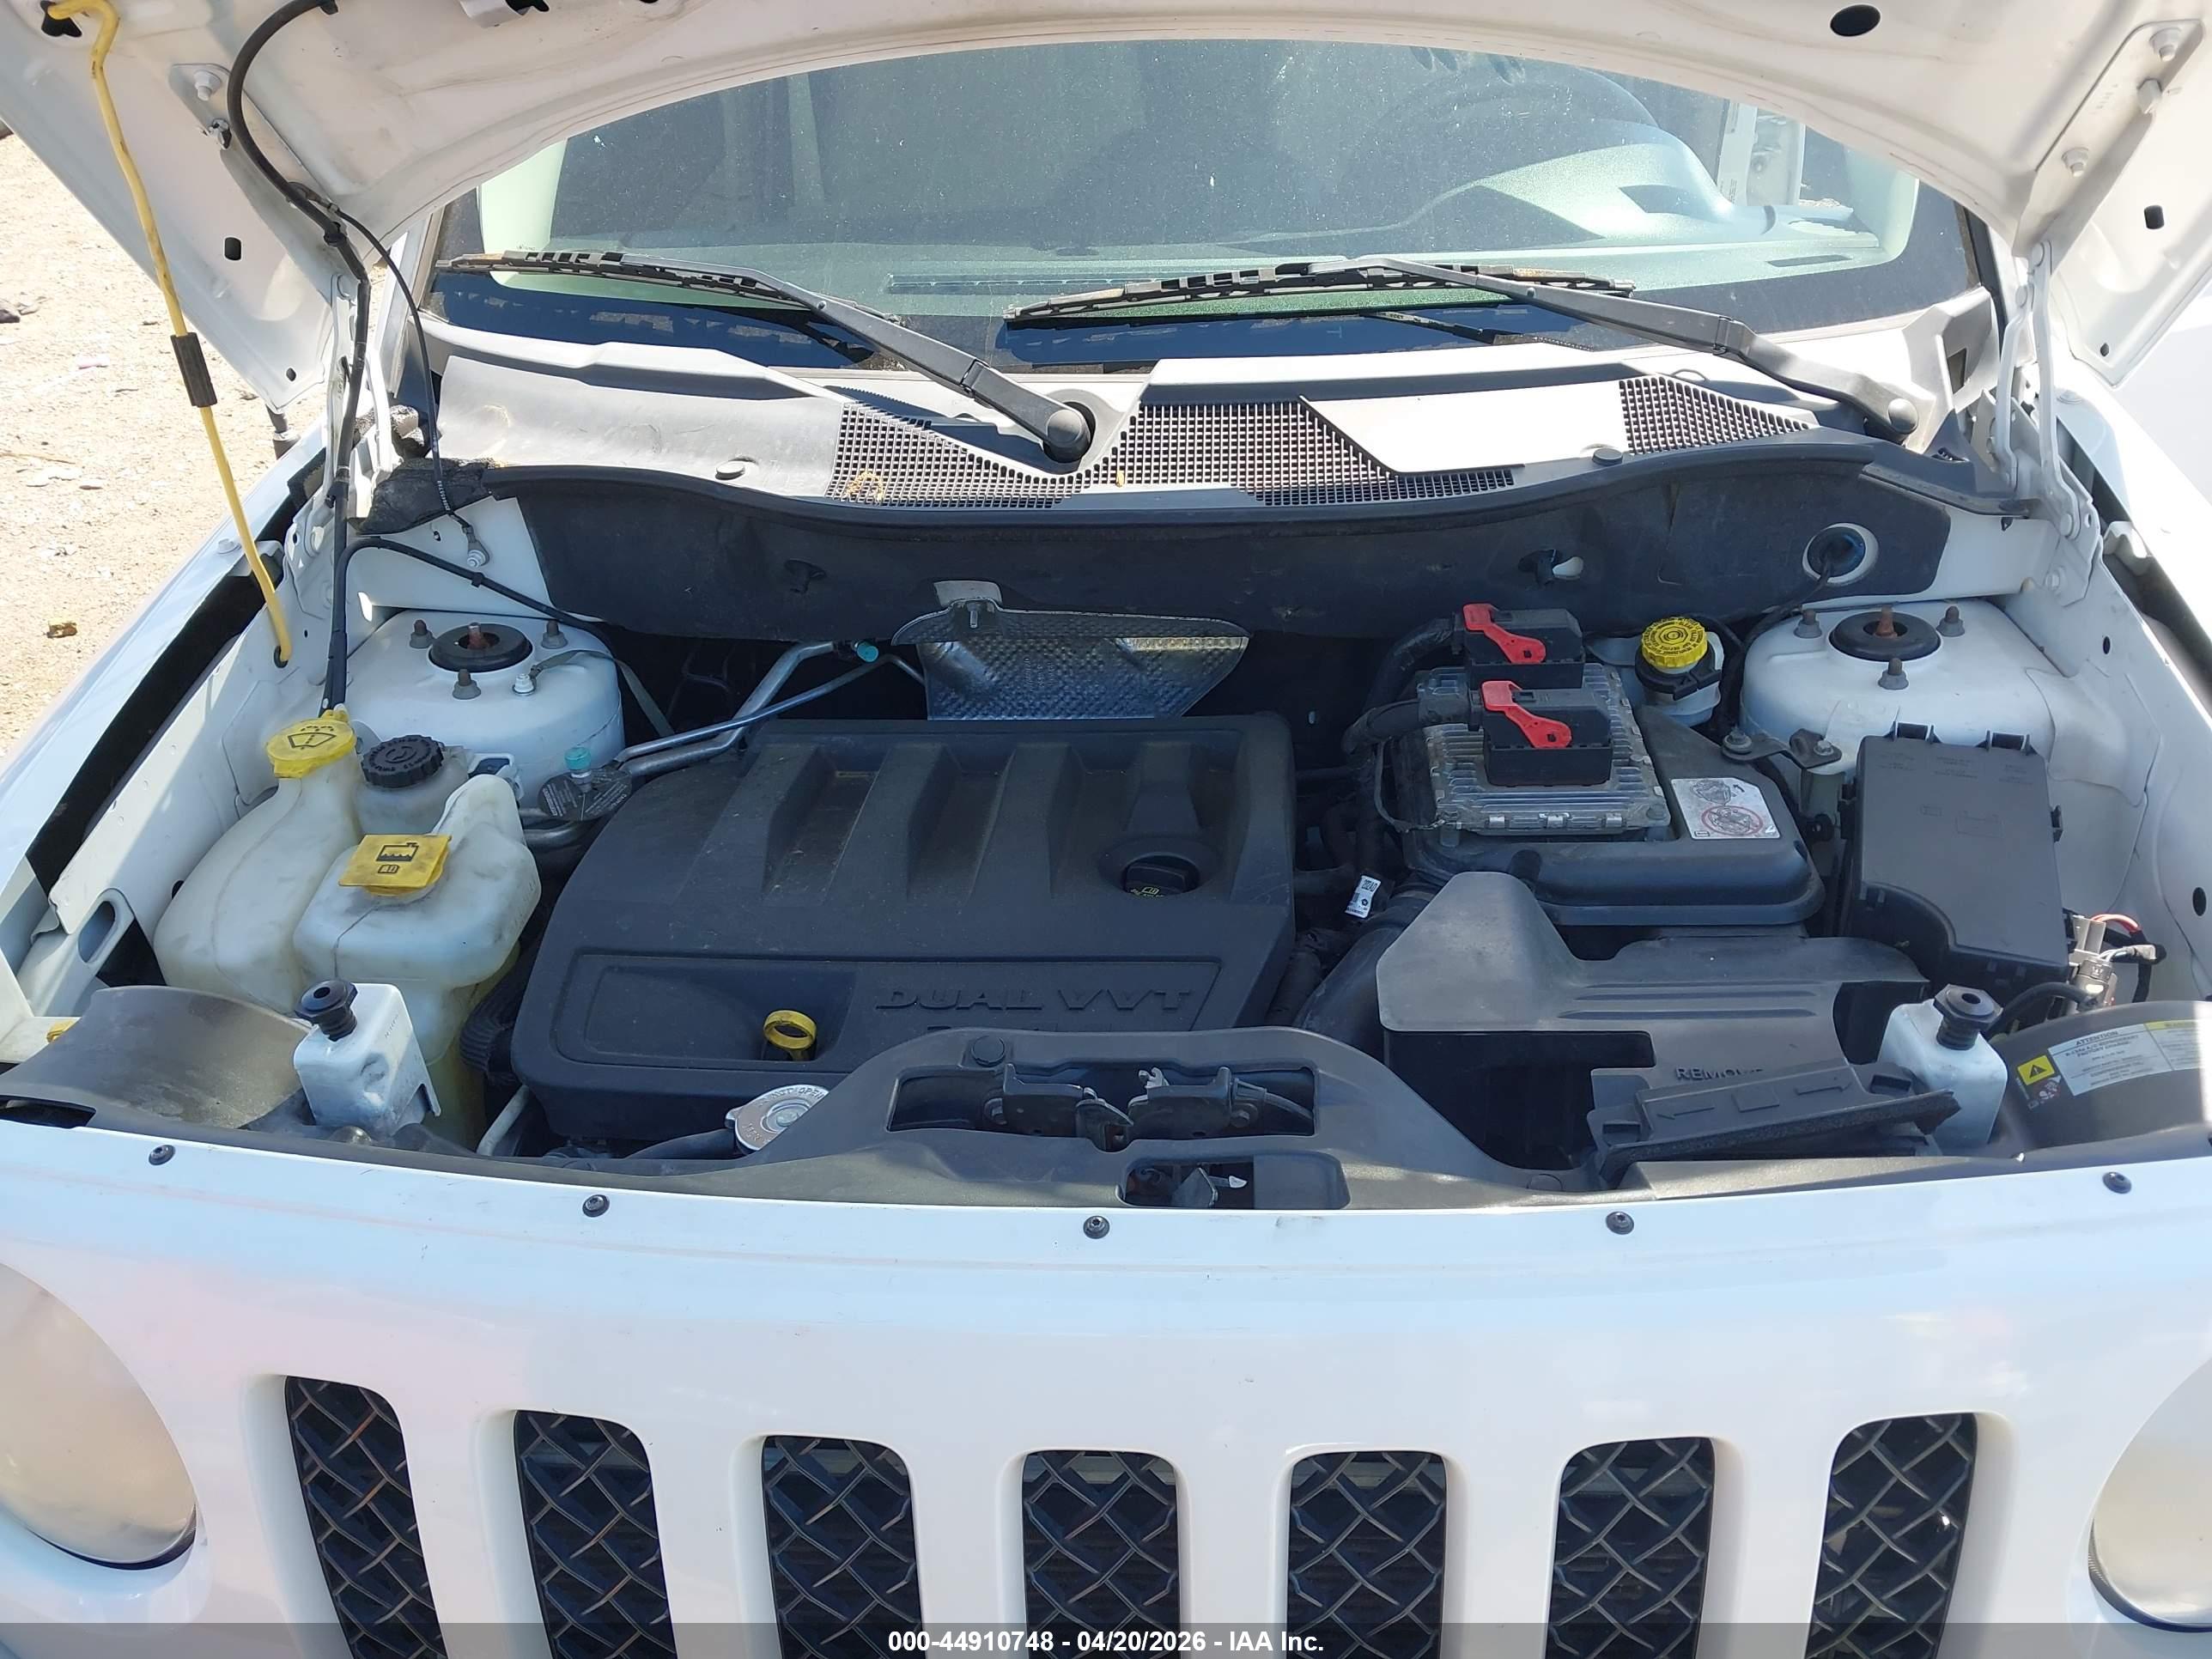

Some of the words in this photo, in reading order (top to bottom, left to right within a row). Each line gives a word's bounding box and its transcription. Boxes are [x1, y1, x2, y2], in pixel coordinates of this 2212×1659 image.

[876, 990, 1042, 1011] DUAL
[1057, 989, 1194, 1011] VVT
[2075, 1030, 2118, 1046] ATTENTION
